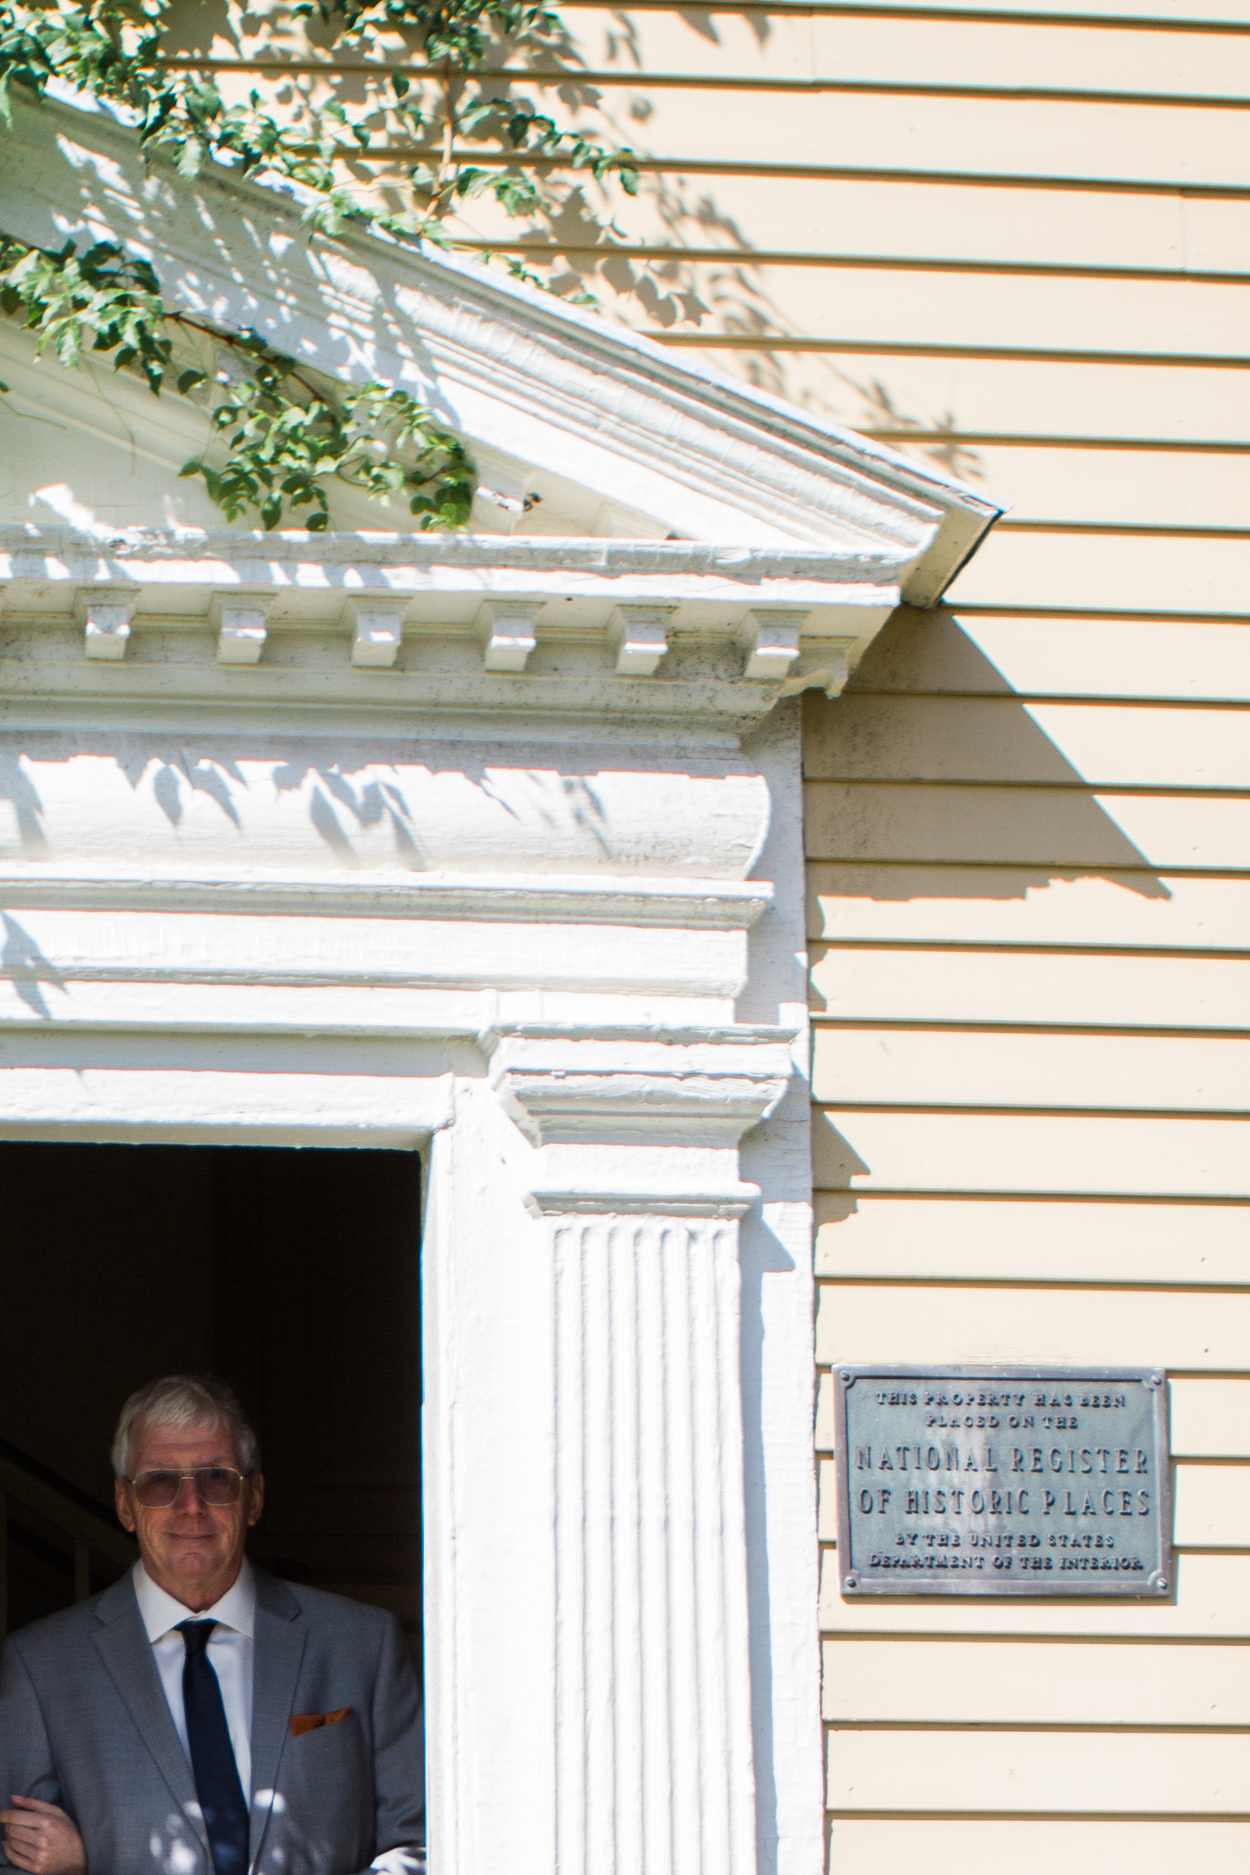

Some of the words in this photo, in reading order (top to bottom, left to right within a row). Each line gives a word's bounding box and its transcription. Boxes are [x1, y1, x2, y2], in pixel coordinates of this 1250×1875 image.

[876, 1391, 918, 1405] THIS
[923, 1391, 1026, 1408] PROPERTY
[1033, 1393, 1073, 1408] HAS
[1079, 1394, 1126, 1408] BEEN
[926, 1415, 1000, 1428] PLACED
[1008, 1415, 1034, 1428] ON
[1042, 1416, 1079, 1429] THE
[856, 1445, 997, 1472] NATIONAL
[1010, 1447, 1148, 1474] REGISTER
[859, 1488, 891, 1515] OF
[904, 1489, 1029, 1515] HISTORIC
[1042, 1489, 1150, 1516] PLACES
[895, 1533, 918, 1546] BY
[922, 1534, 961, 1547] THE
[969, 1534, 1040, 1548] UNITED
[1048, 1534, 1114, 1548] STATES
[869, 1553, 984, 1569] DEPARTMENT
[992, 1555, 1012, 1569] OF
[1020, 1555, 1053, 1570] THE
[1059, 1556, 1143, 1571] INTERIOR
